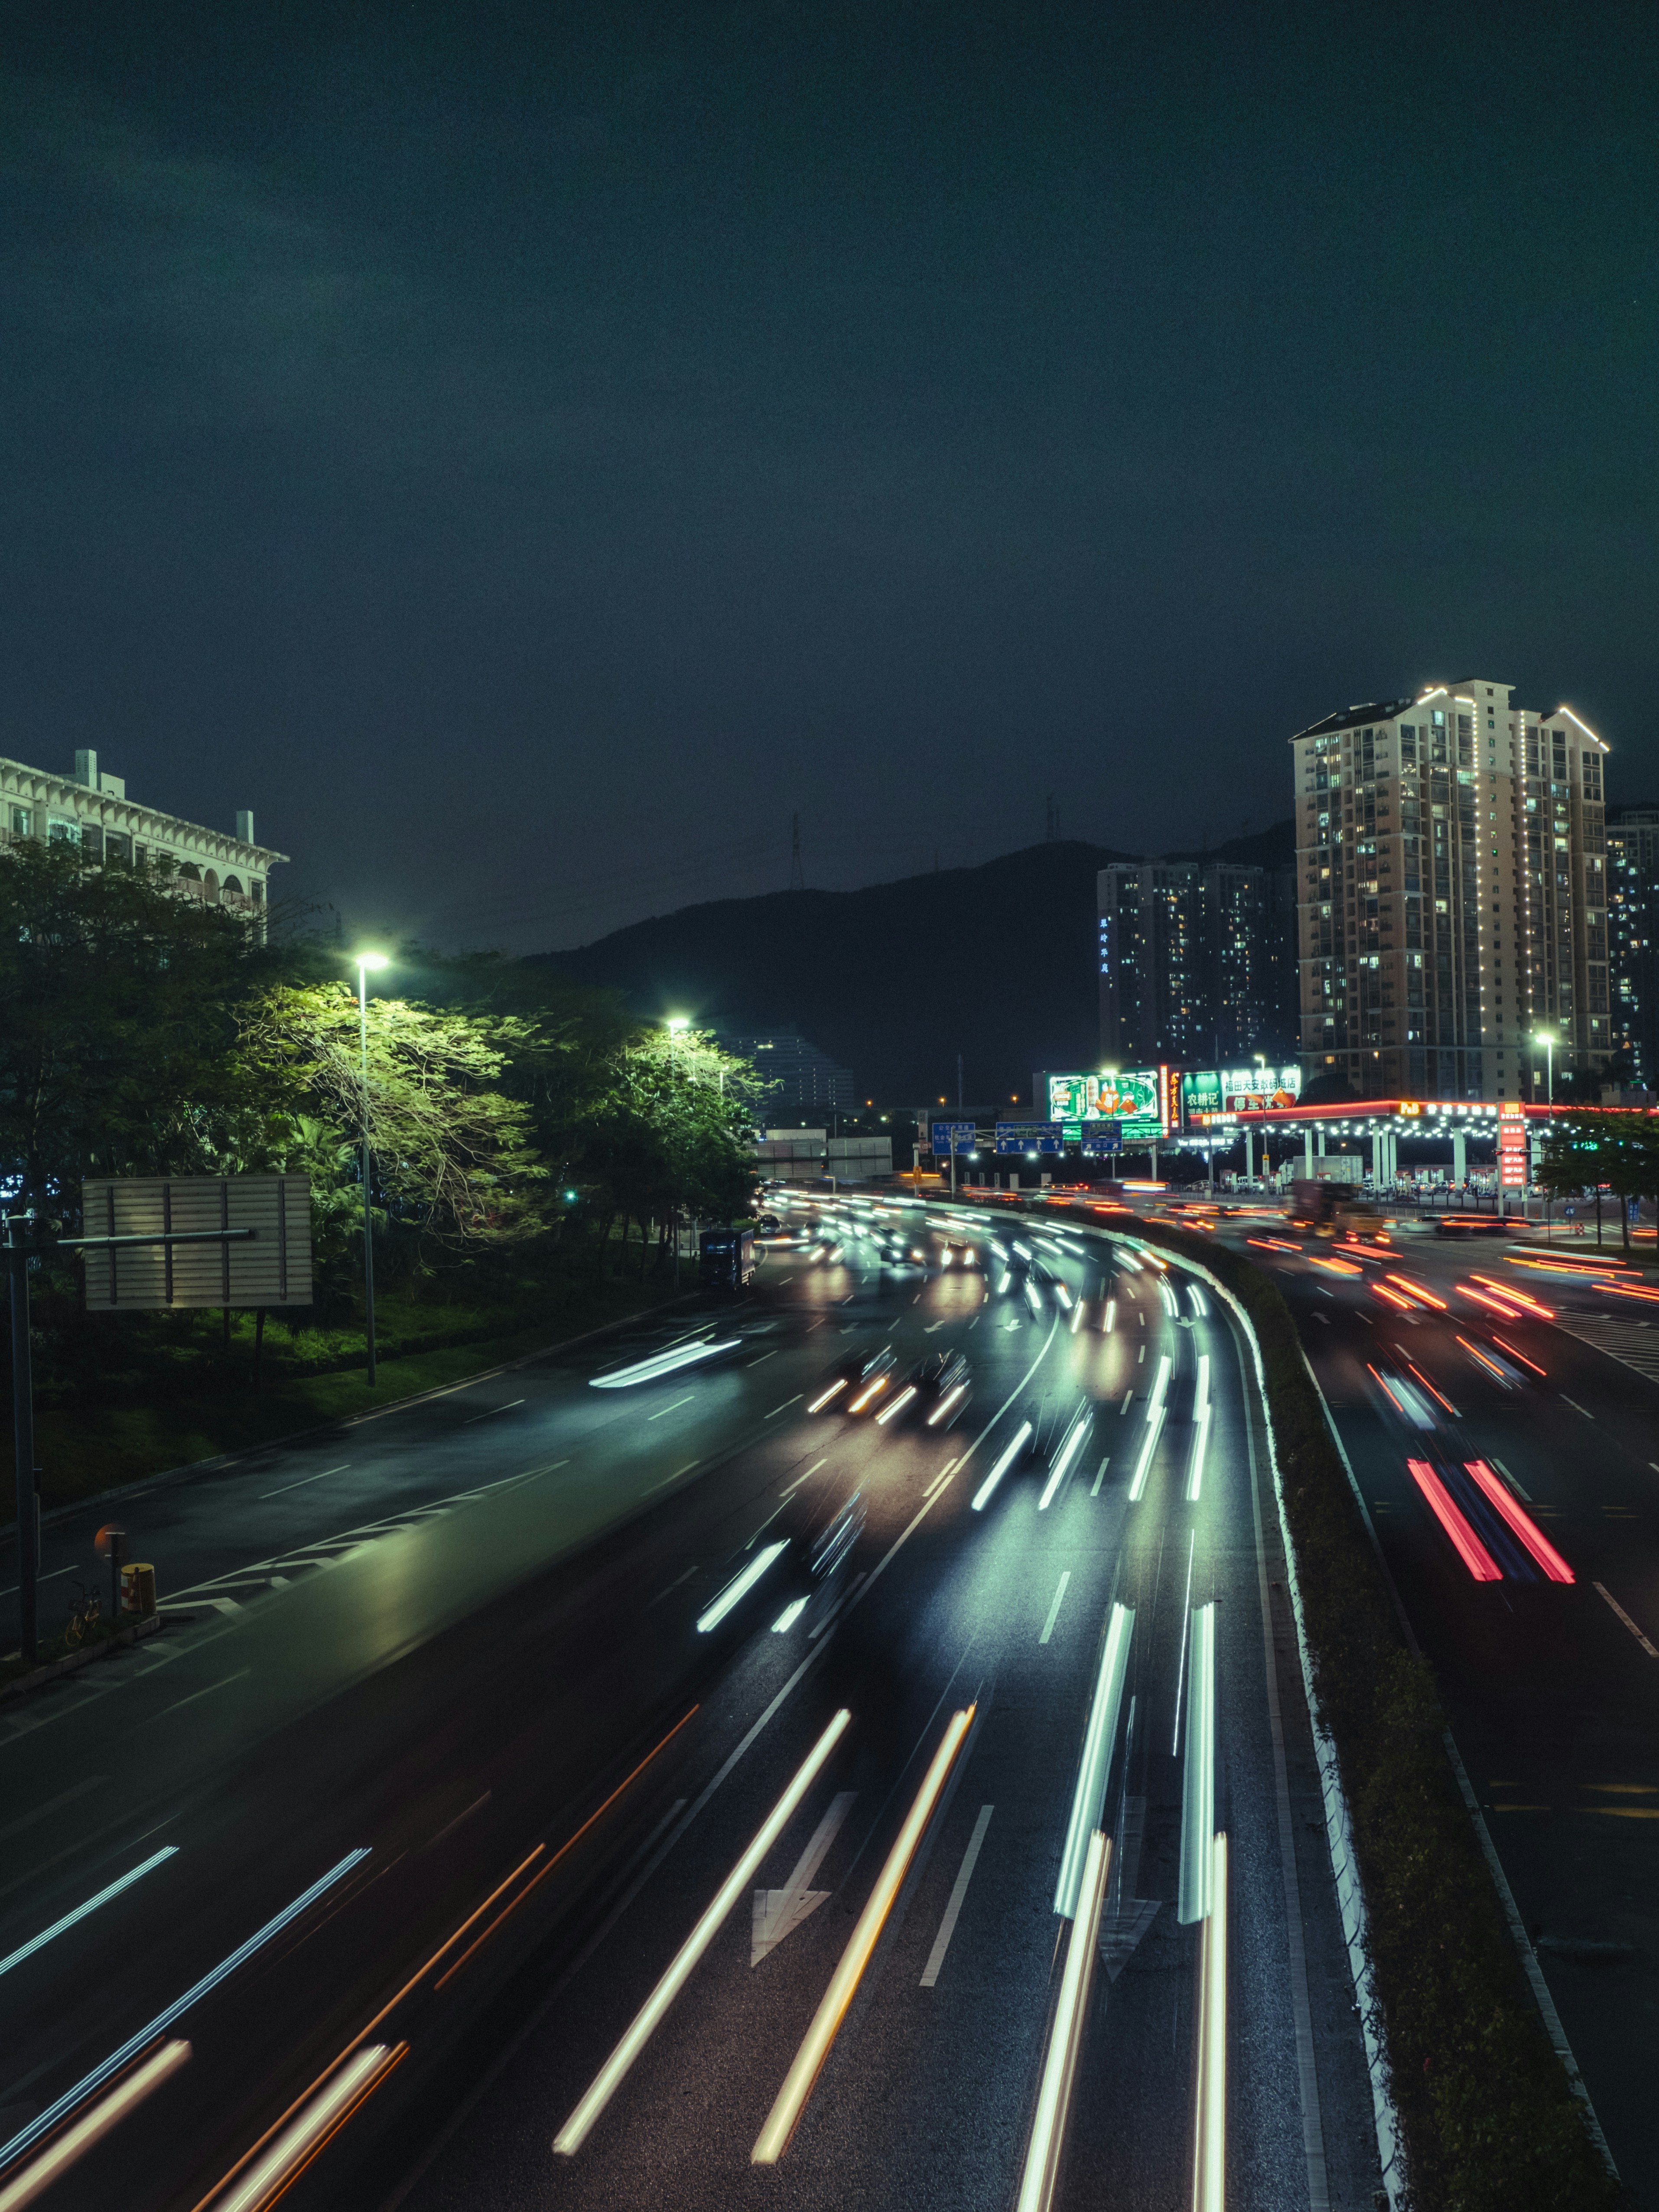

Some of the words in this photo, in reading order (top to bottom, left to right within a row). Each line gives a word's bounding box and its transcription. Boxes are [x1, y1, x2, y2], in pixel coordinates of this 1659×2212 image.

[1226, 1078, 1296, 1092] 福田天安数码城店
[1187, 1093, 1218, 1106] 农耕记
[1234, 1095, 1287, 1111] 停车优
